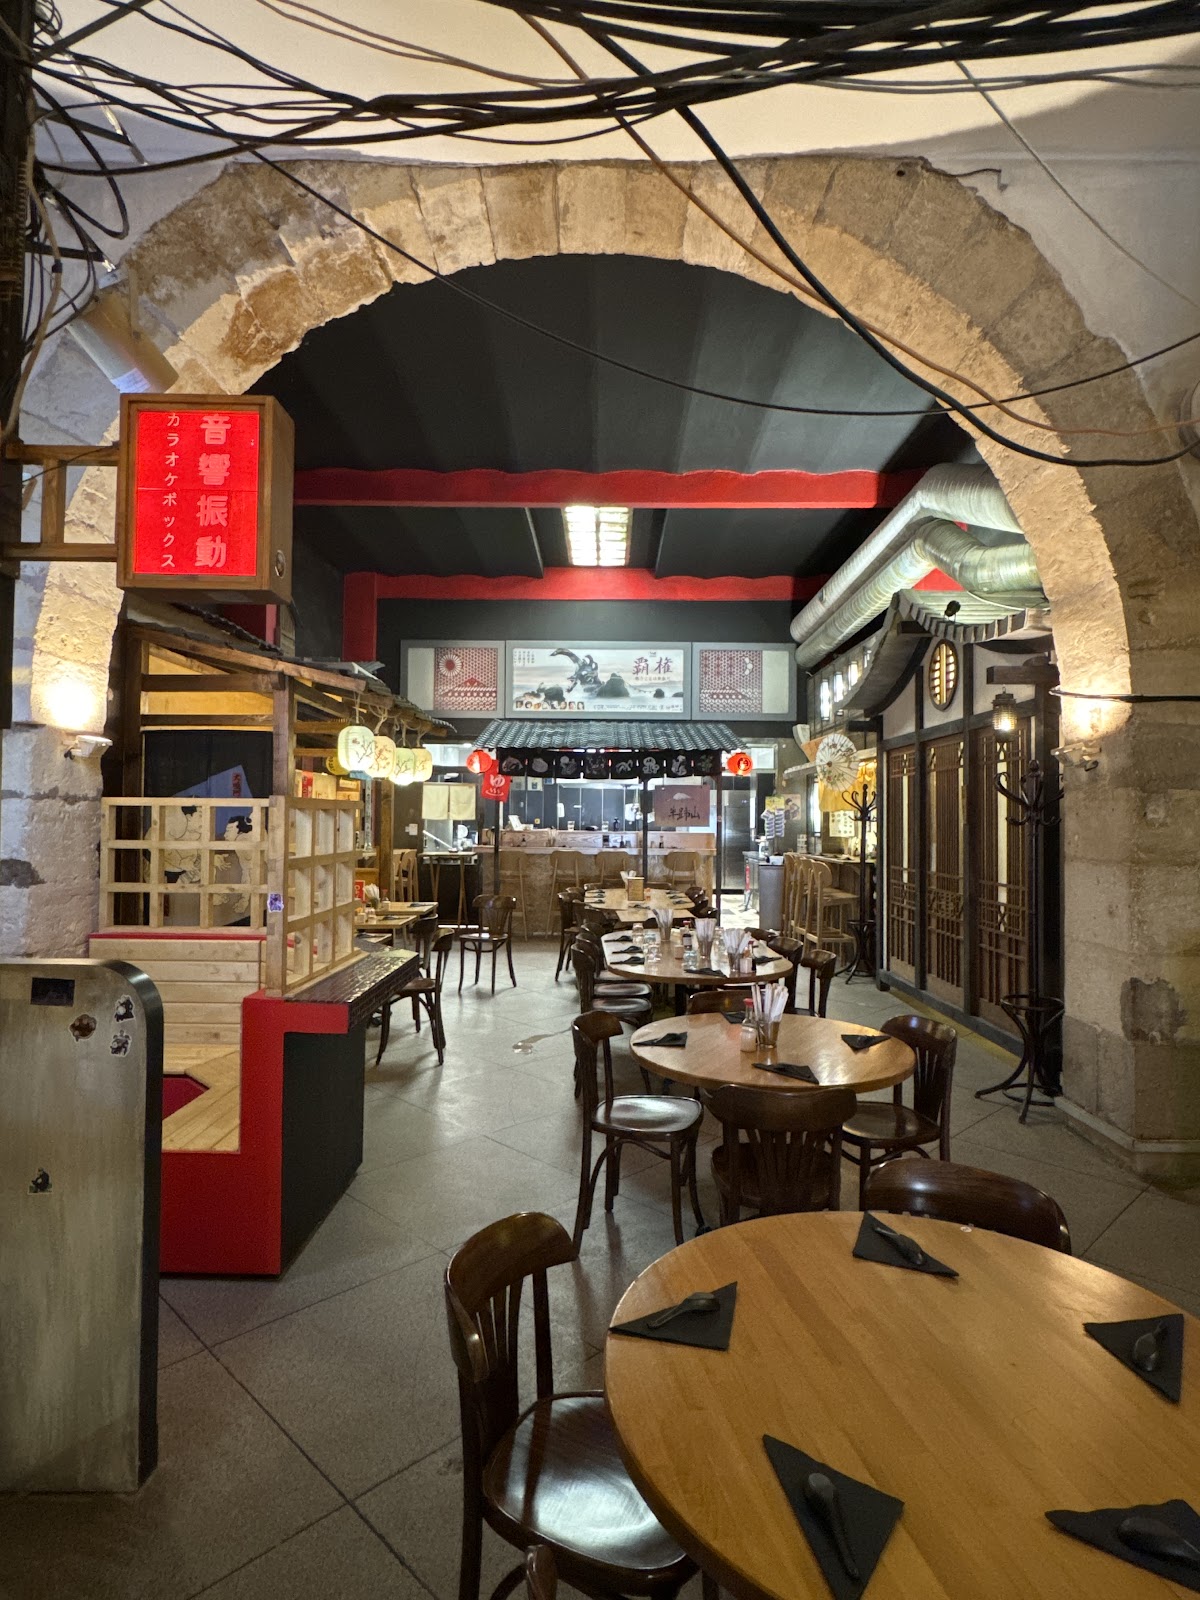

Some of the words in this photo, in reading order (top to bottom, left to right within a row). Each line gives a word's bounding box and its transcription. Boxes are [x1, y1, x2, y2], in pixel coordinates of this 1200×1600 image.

[161, 412, 181, 568] カラオケボックス
[188, 413, 231, 568] 音響振動
[489, 774, 506, 787] ゆ
